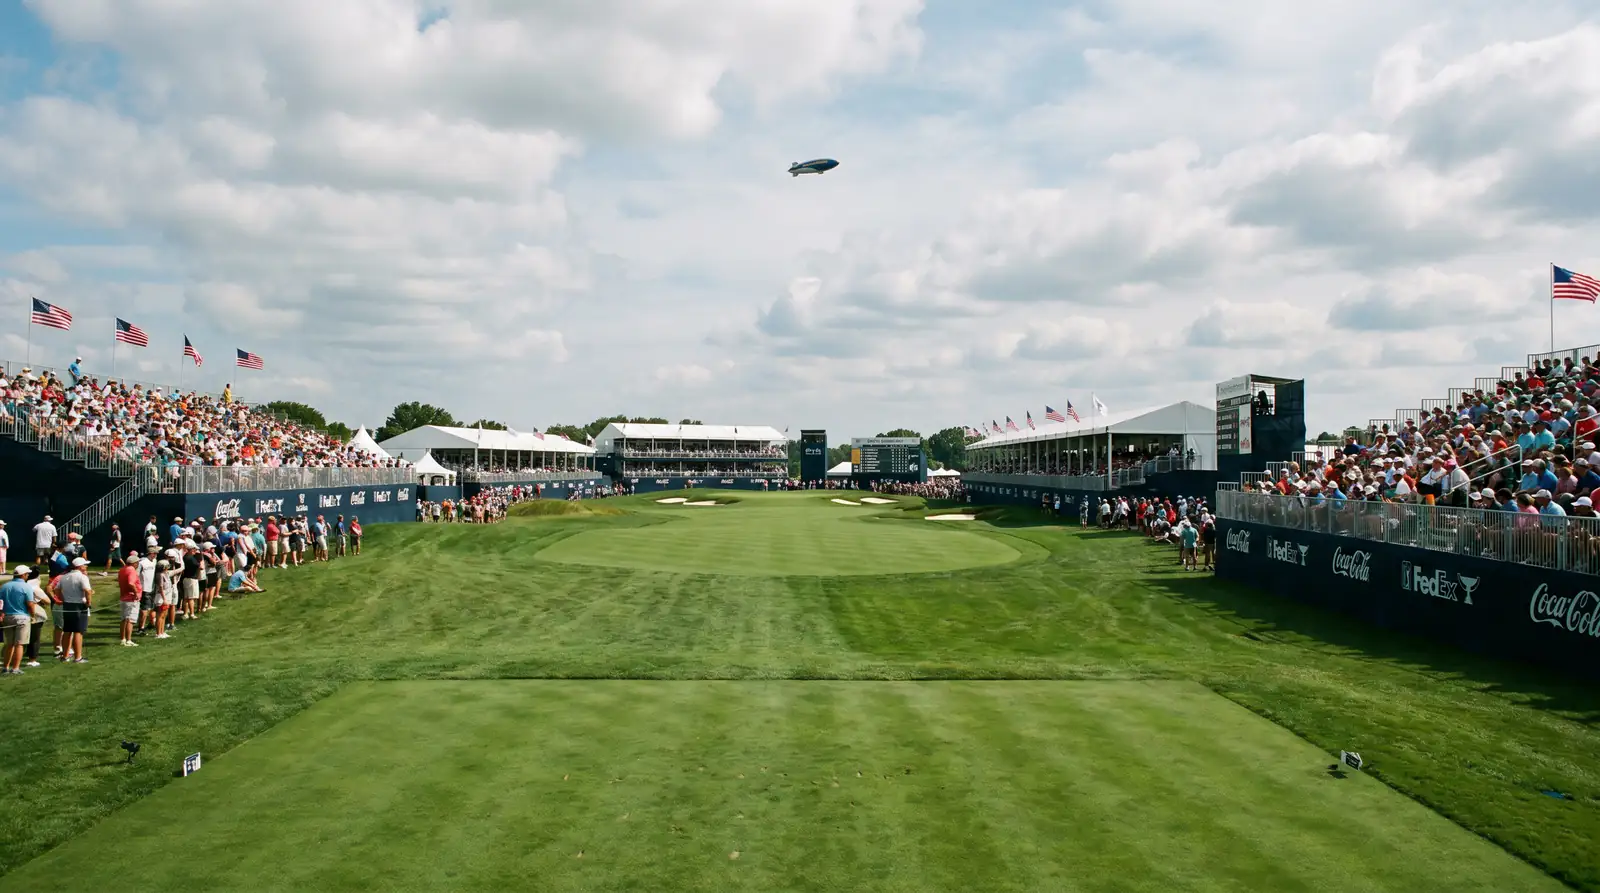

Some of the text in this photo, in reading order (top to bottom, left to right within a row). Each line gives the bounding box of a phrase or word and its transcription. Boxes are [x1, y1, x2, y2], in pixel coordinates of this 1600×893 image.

[1226, 527, 1250, 553] Coca-Cola
[1273, 539, 1298, 564] FedEx
[1332, 546, 1372, 582] Coca-Cola
[1413, 565, 1458, 601] FedEx
